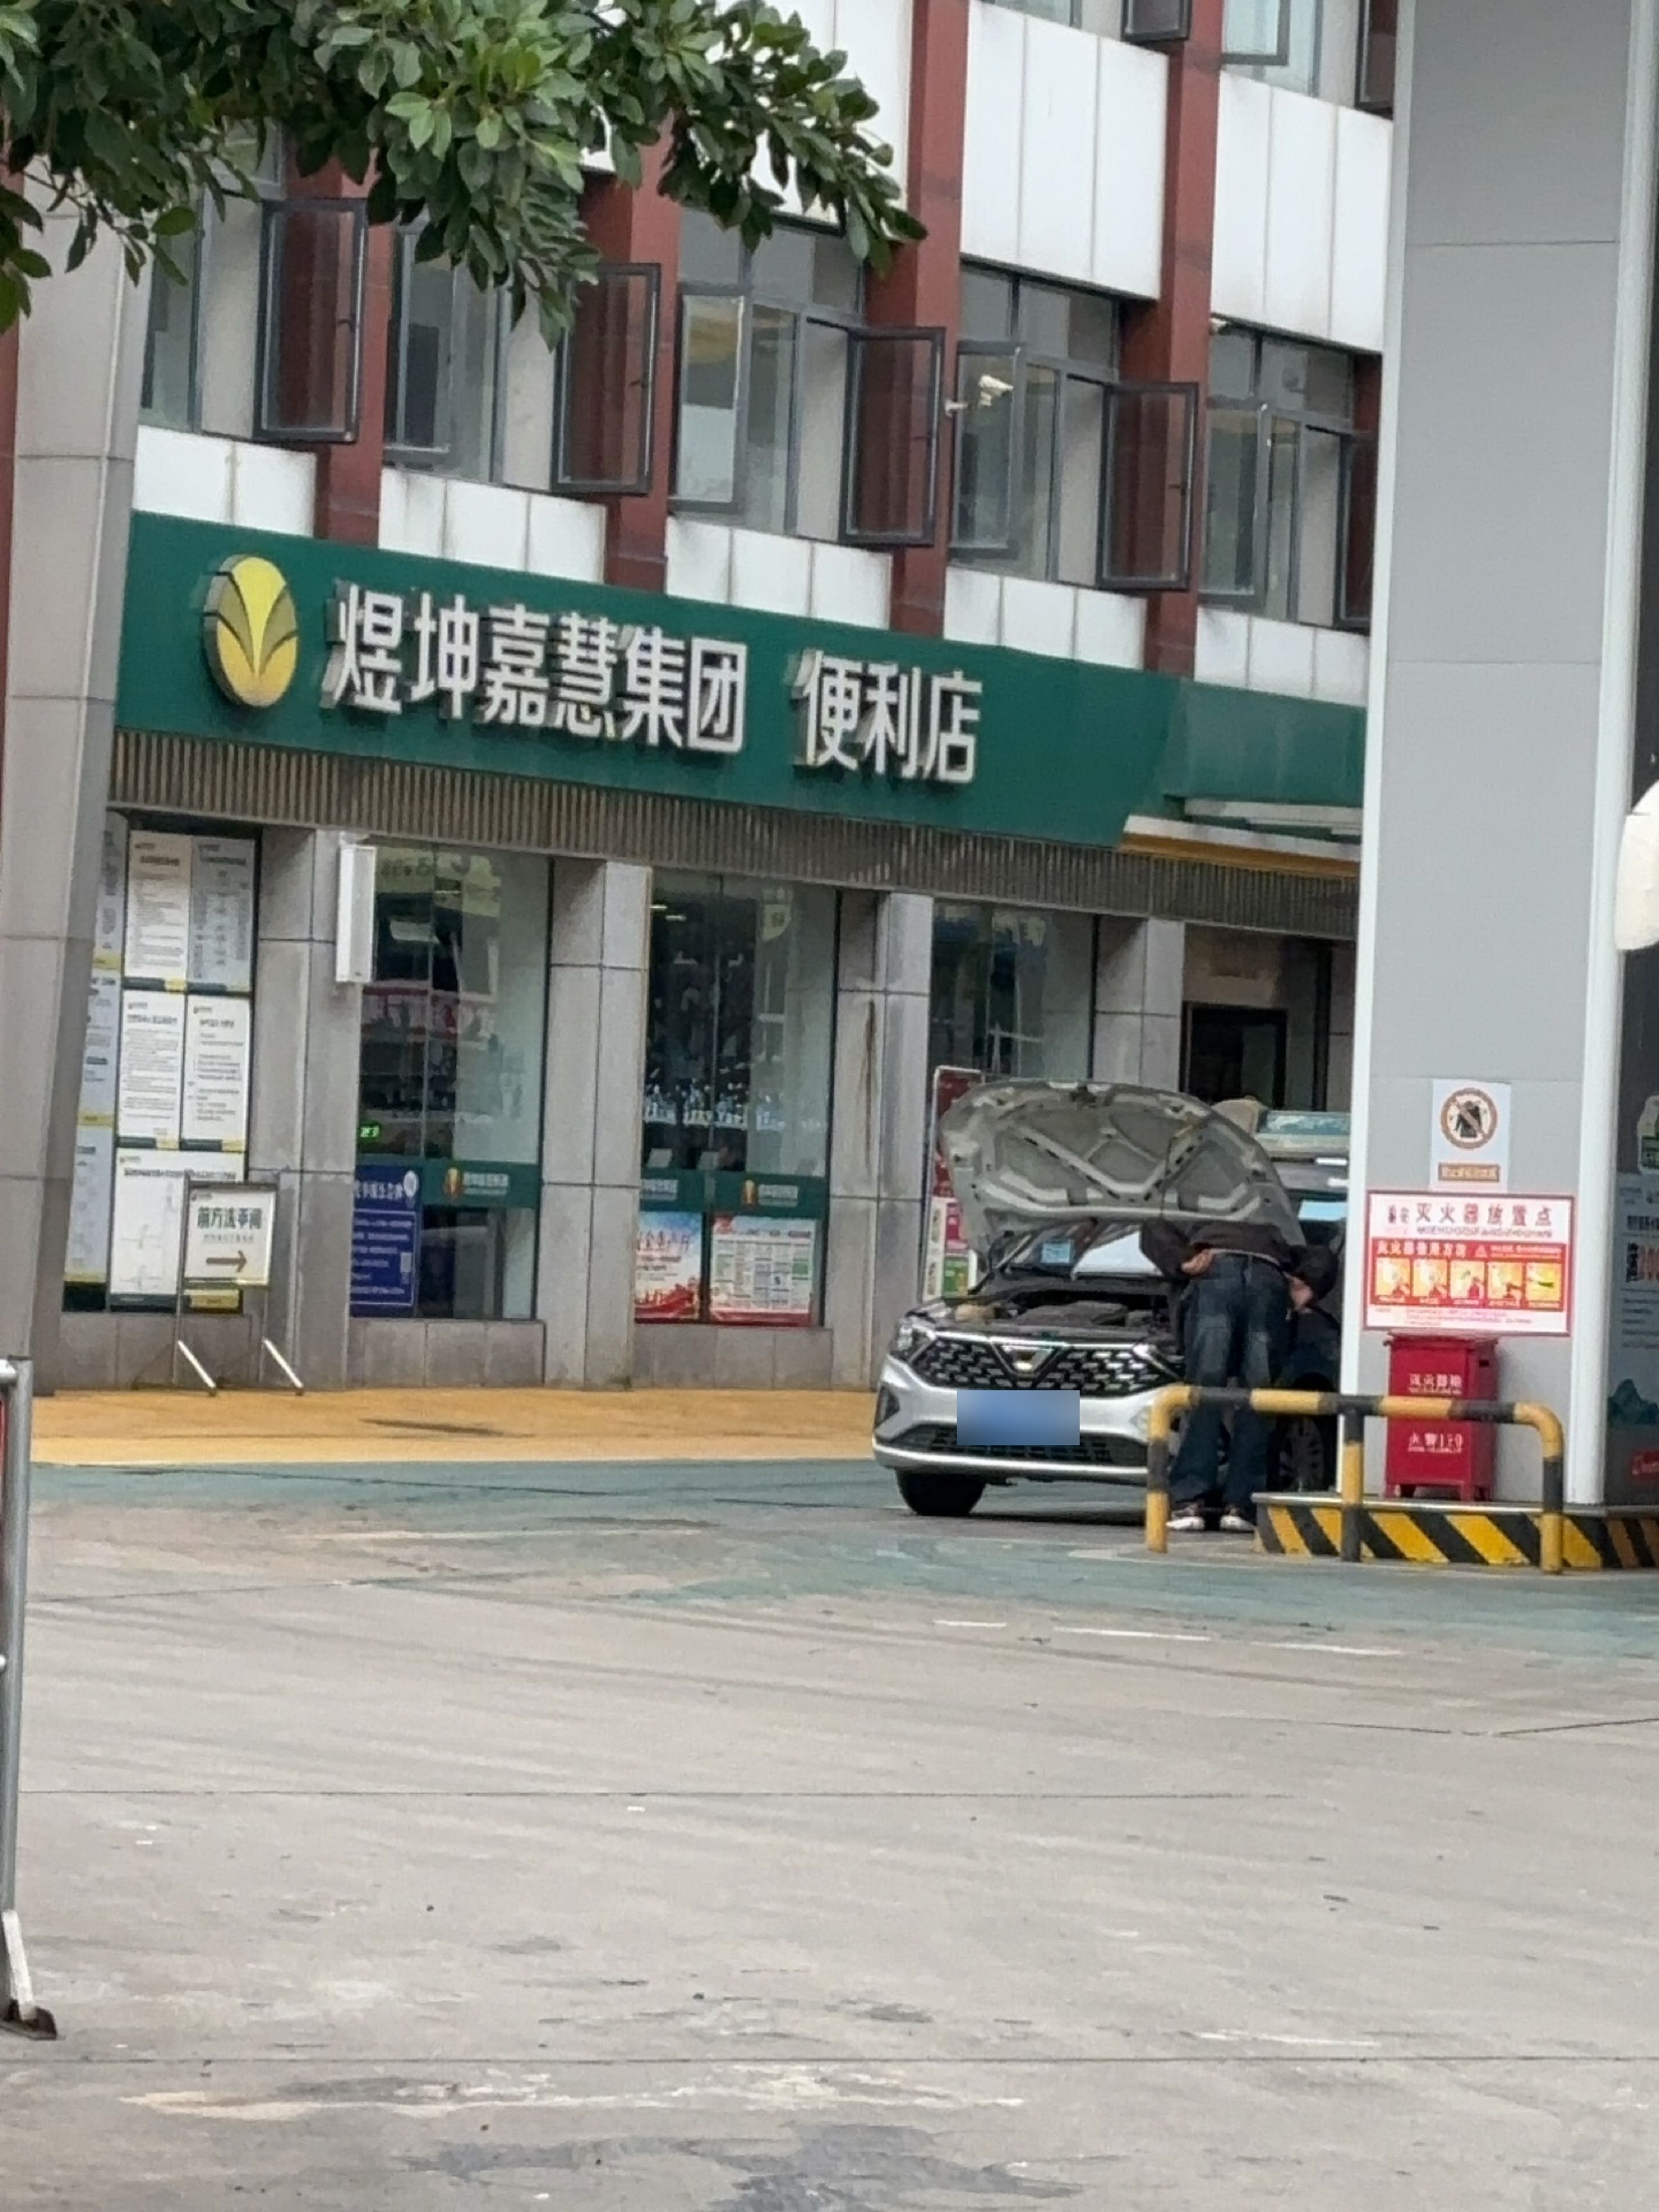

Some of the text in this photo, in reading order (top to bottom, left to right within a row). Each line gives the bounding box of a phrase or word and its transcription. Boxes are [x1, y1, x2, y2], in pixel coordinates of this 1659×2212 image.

[325, 581, 982, 785] 煜坤嘉慧集团 便利店
